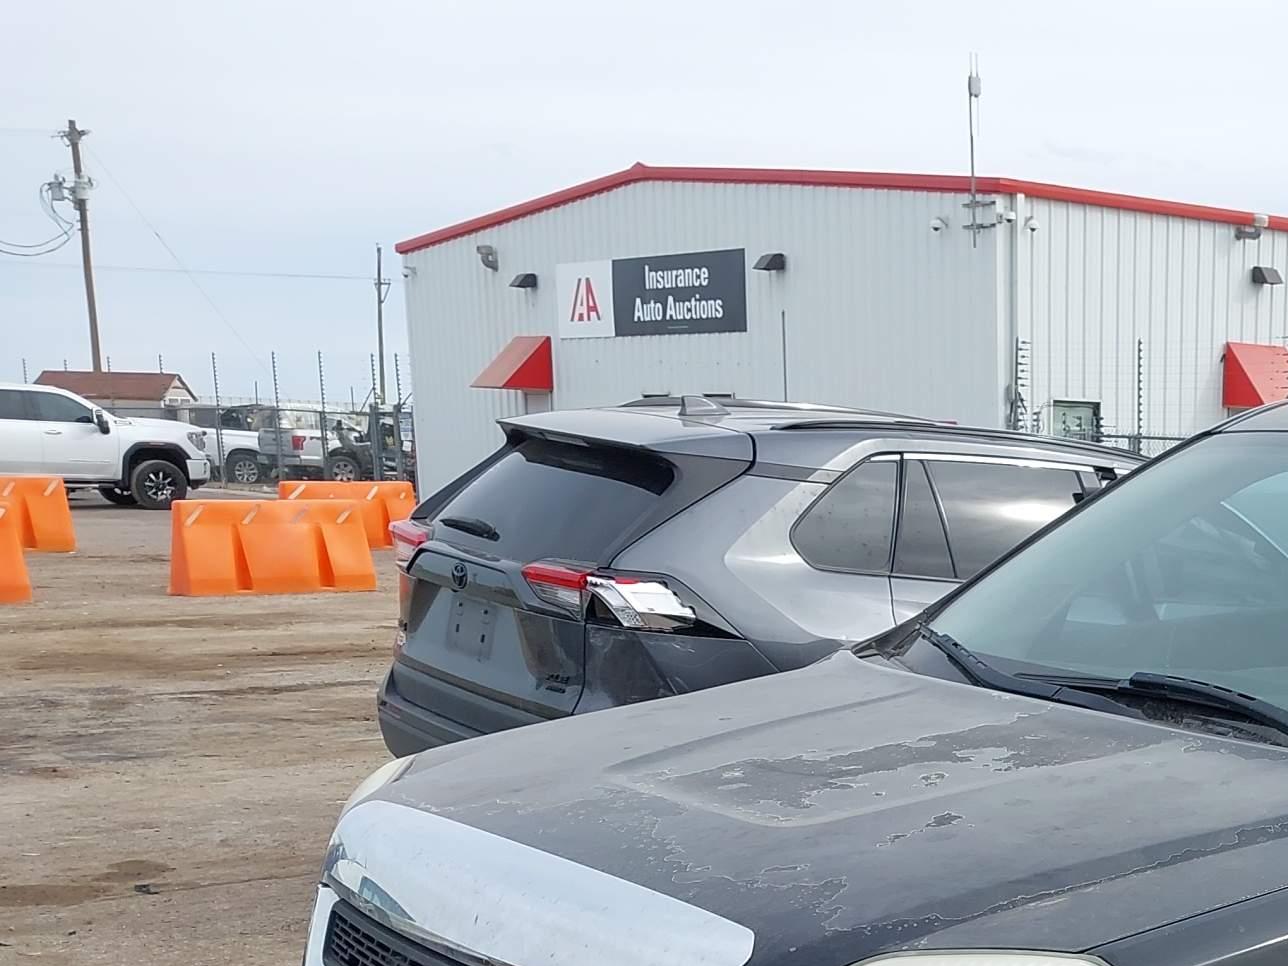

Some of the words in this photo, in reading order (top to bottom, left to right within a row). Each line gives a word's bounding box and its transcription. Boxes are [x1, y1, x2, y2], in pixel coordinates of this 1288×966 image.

[644, 264, 709, 290] Insurance
[633, 297, 663, 322] Auto
[666, 294, 724, 320] Auctions
